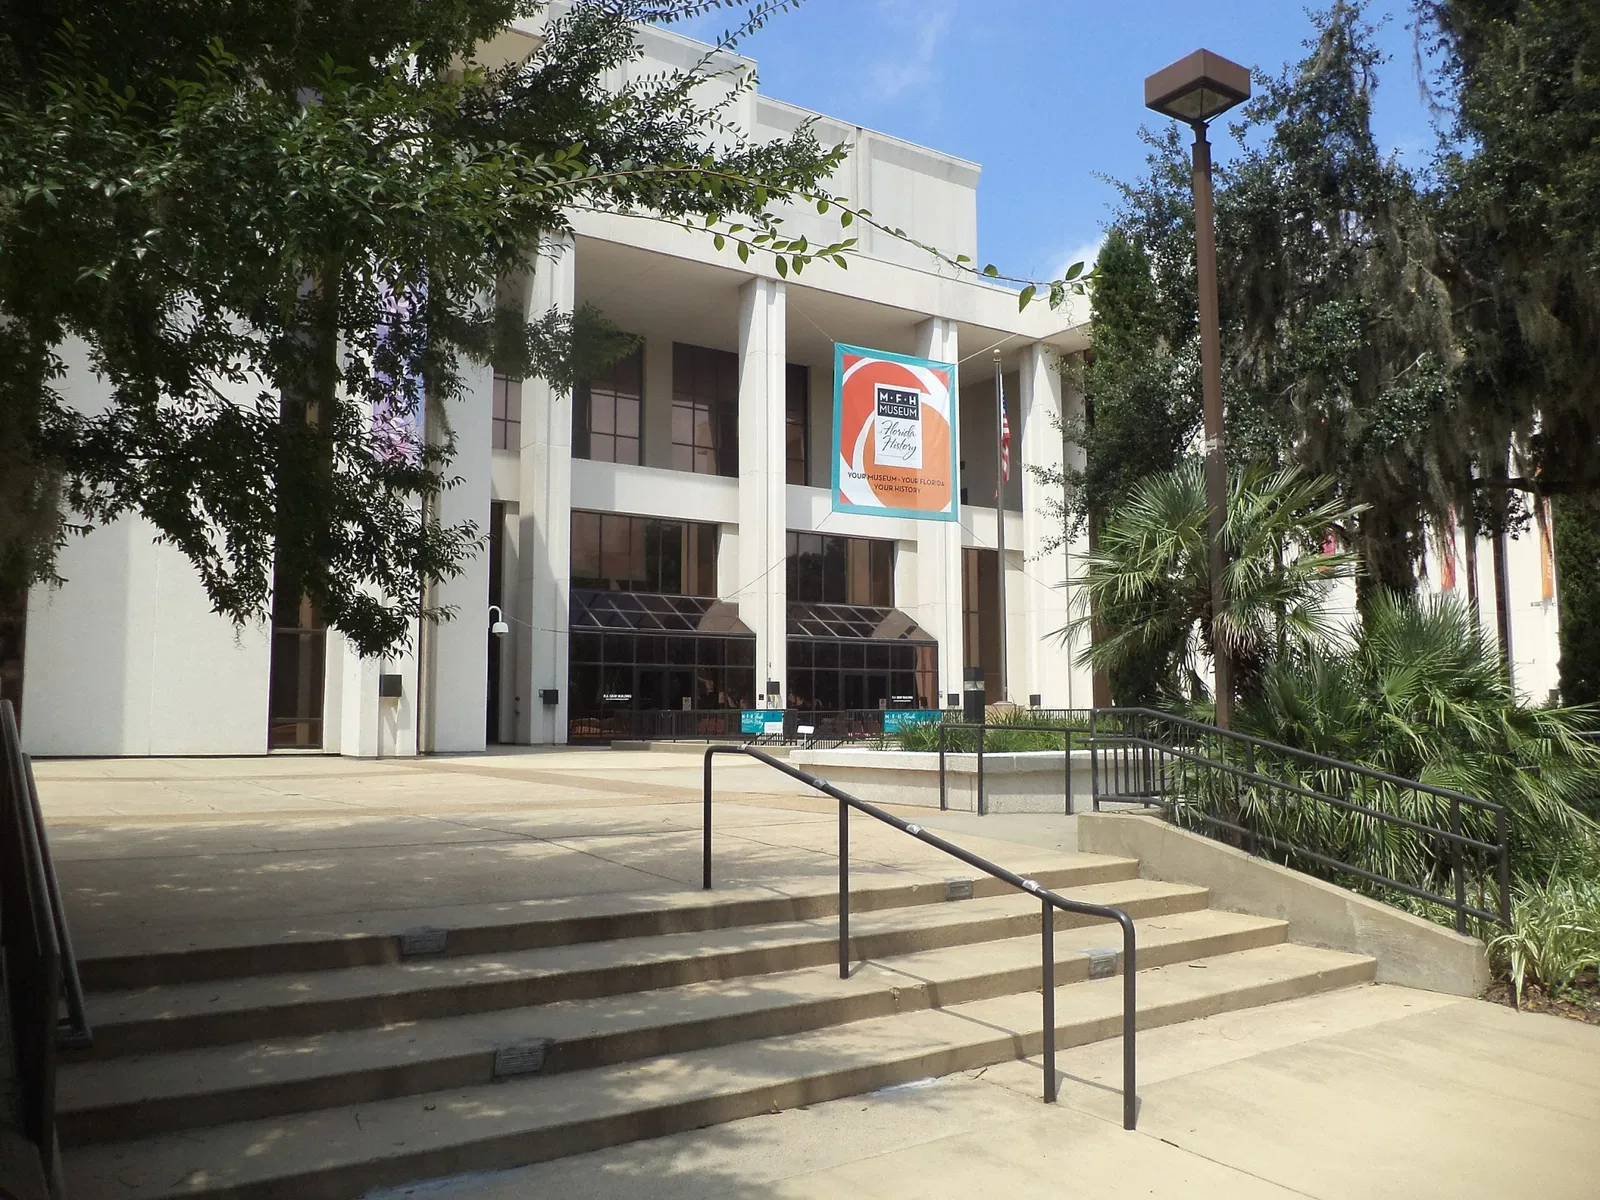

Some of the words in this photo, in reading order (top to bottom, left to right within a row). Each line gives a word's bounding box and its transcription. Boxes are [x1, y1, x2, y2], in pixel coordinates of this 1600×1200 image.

[879, 404, 918, 417] MUSEUM
[881, 420, 916, 438] Florida
[882, 435, 917, 460] History
[847, 472, 867, 480] YOUR
[867, 474, 897, 483] MUSEUM
[901, 477, 919, 485] YOUR
[919, 478, 945, 488] FLORIDA
[873, 483, 894, 492] YOUR
[894, 486, 921, 494] HISTORY
